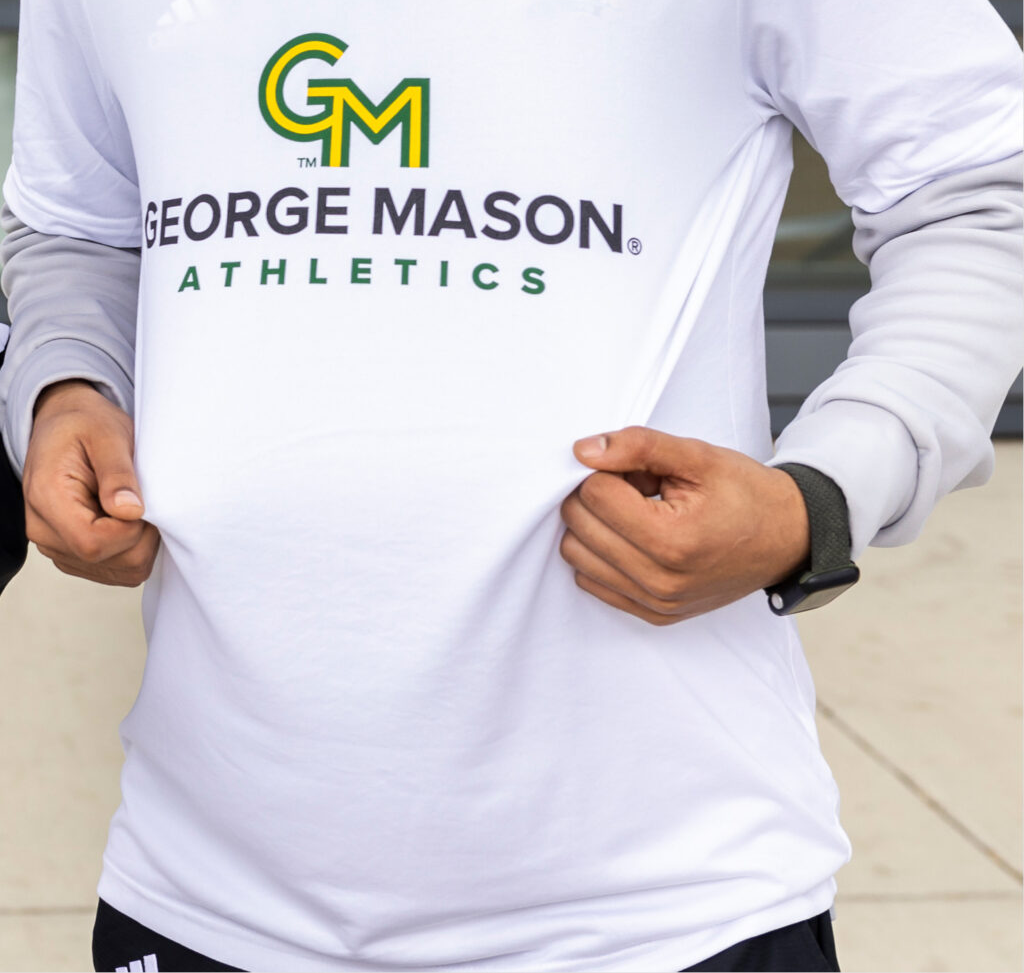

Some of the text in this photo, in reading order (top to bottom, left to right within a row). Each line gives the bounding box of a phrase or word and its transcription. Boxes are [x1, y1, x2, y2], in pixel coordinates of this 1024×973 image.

[258, 33, 431, 169] GM
[144, 186, 351, 250] GEORGE
[177, 257, 546, 296] ATHLETICS
